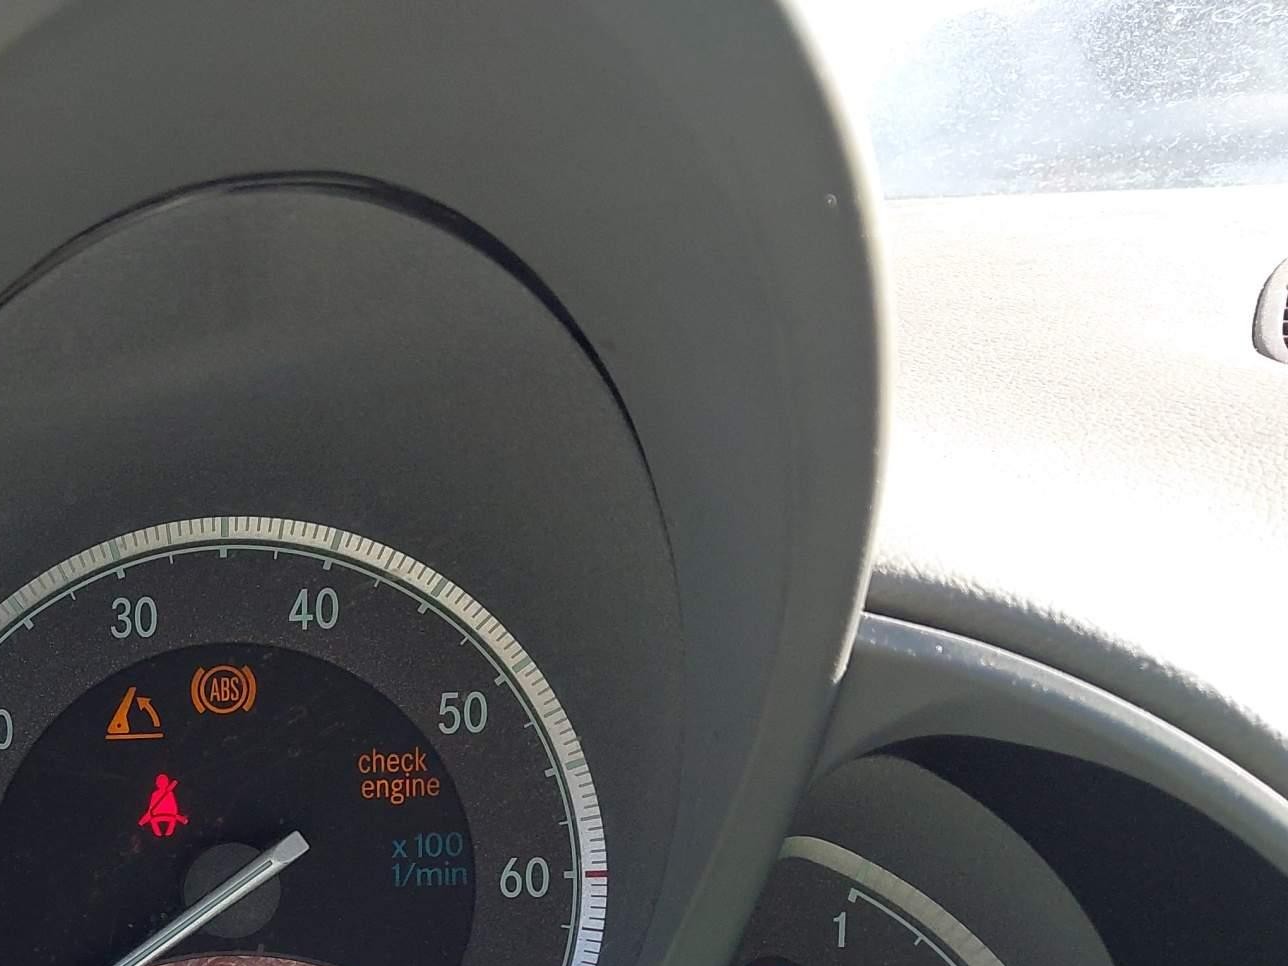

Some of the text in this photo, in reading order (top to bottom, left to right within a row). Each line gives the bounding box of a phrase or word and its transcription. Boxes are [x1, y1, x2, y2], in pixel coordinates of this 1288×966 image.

[109, 596, 158, 639] 30
[288, 587, 340, 631] 40
[210, 676, 240, 702] ABS
[438, 691, 489, 735] 50
[358, 746, 428, 774] check
[361, 772, 441, 805] engine
[391, 860, 469, 888] 1/min
[499, 856, 551, 899] 60
[832, 911, 846, 948] 1
